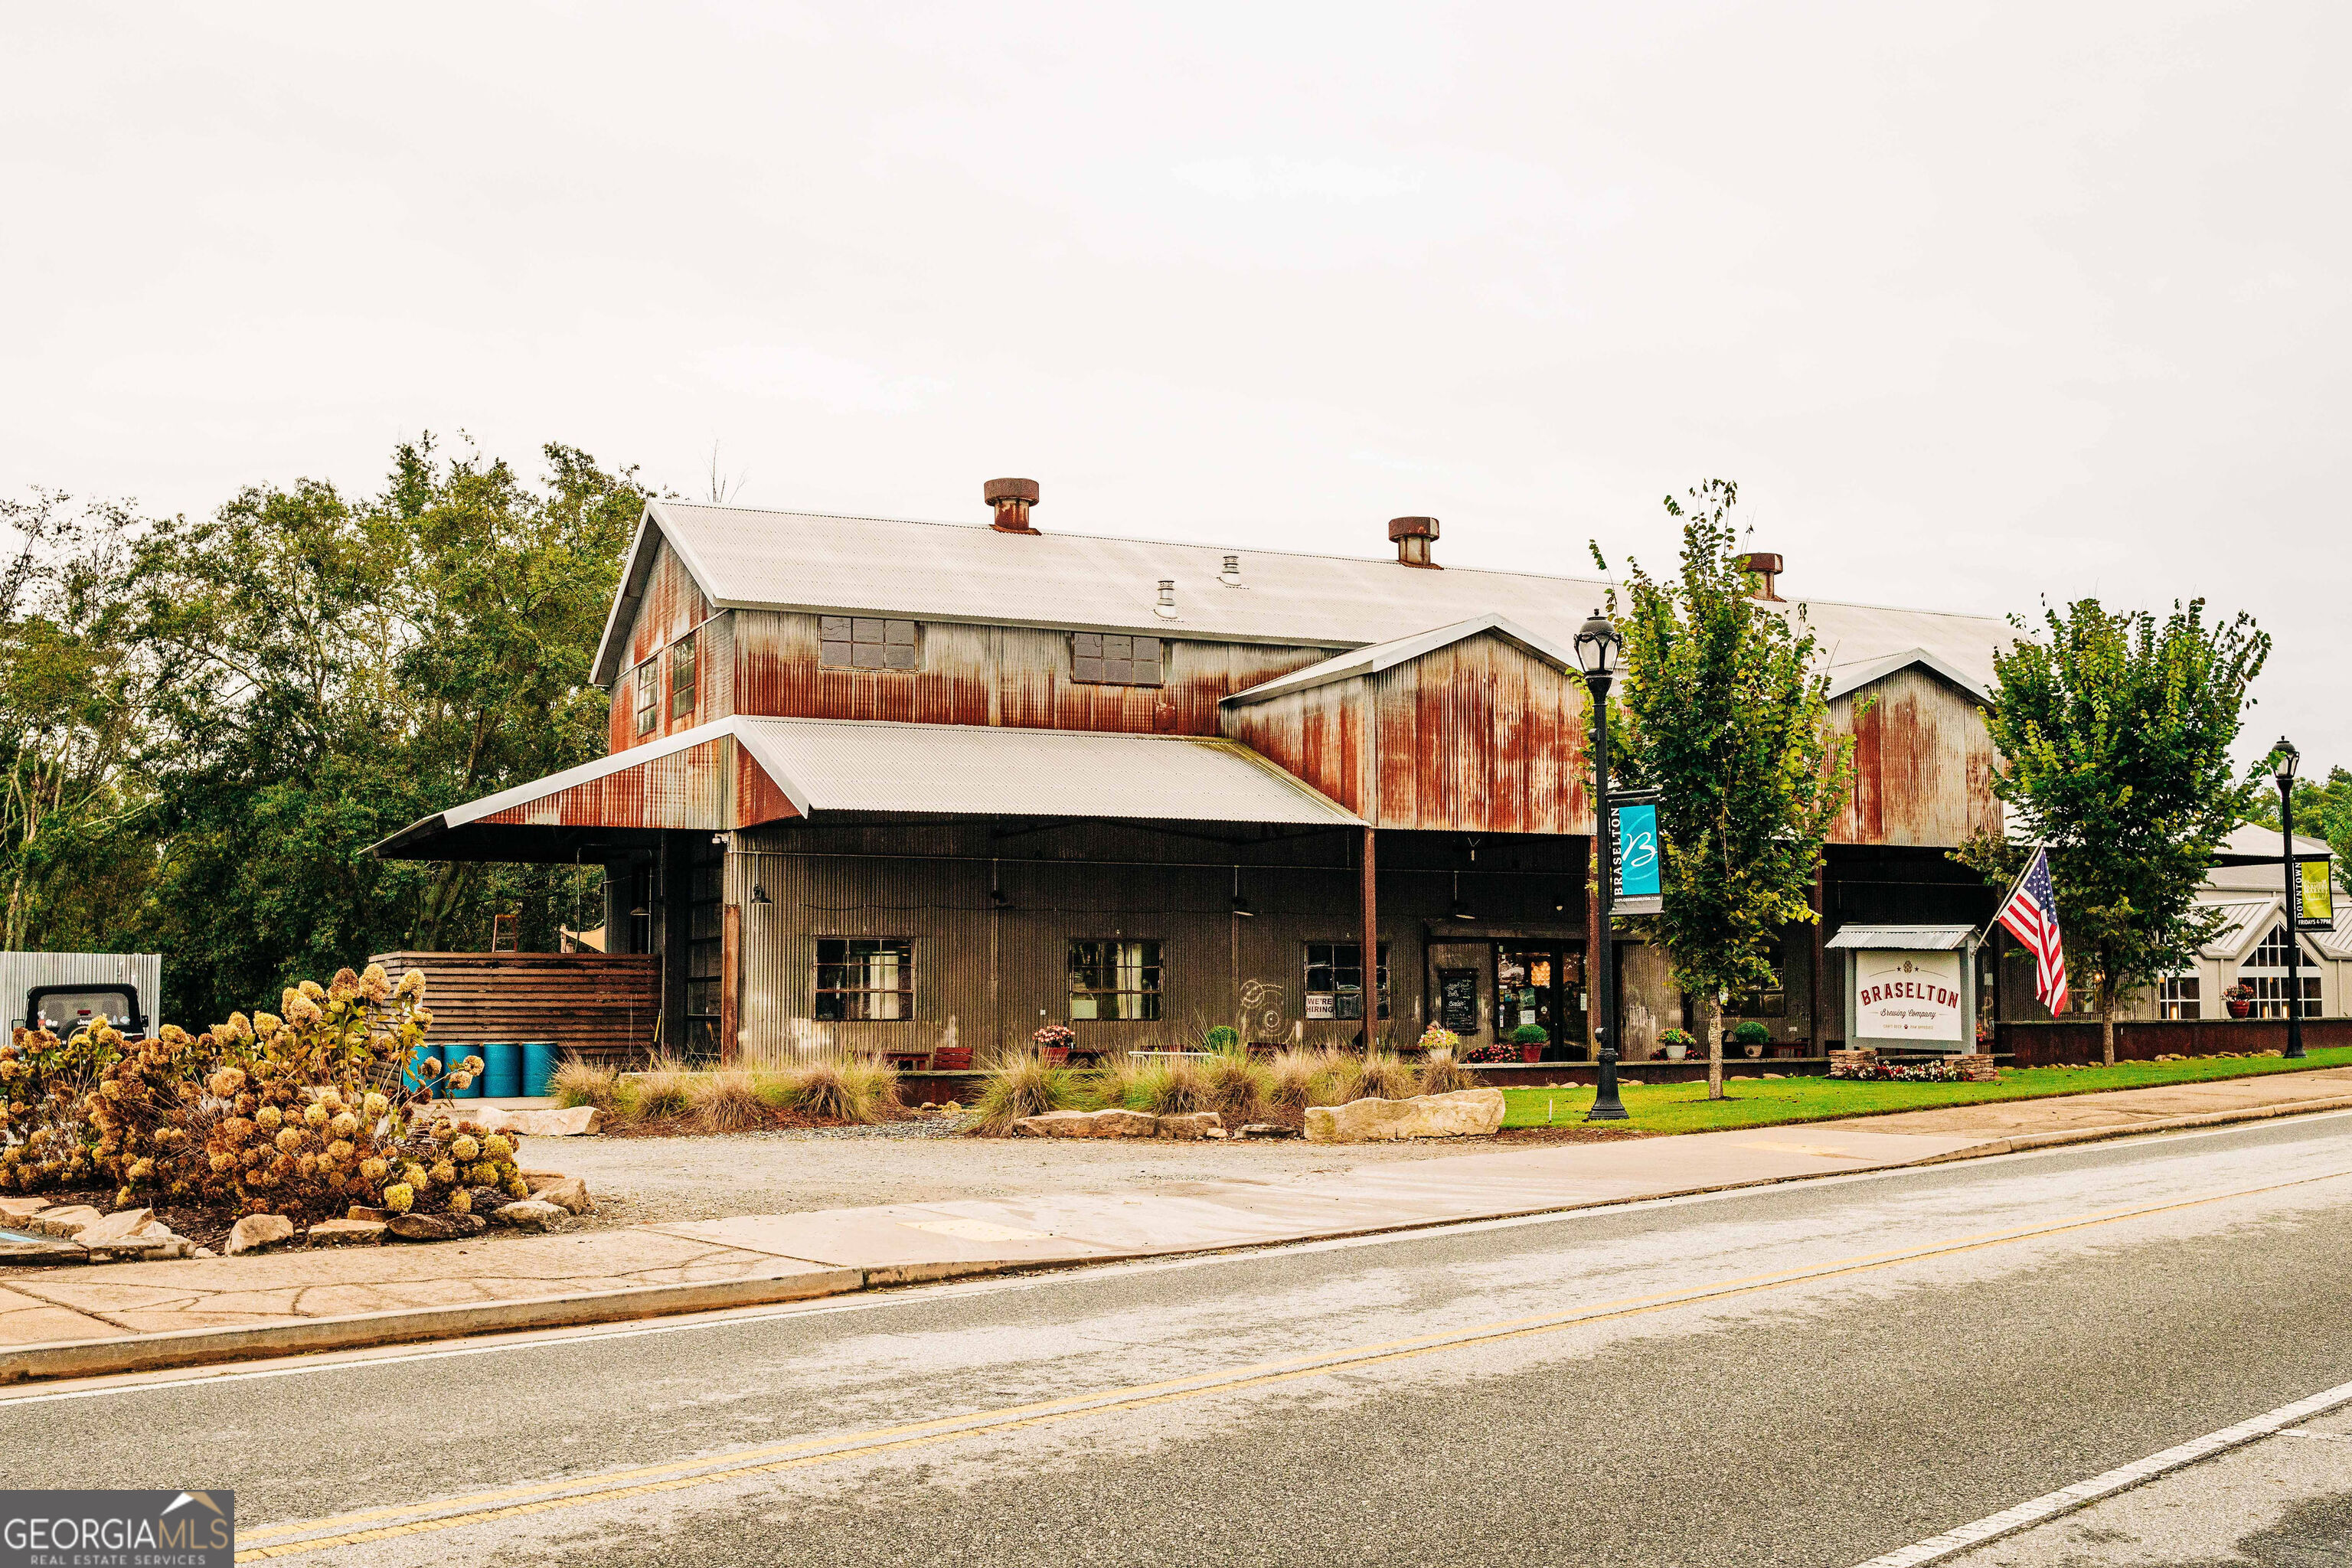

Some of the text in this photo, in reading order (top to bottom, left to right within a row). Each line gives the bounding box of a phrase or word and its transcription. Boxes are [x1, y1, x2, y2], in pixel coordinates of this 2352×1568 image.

[1611, 807, 1623, 896] BRASELTON
[2295, 862, 2304, 919] DOWNTOWN
[1860, 982, 1959, 1009] BRASELTON
[1880, 1008, 1936, 1020] Brewing Company
